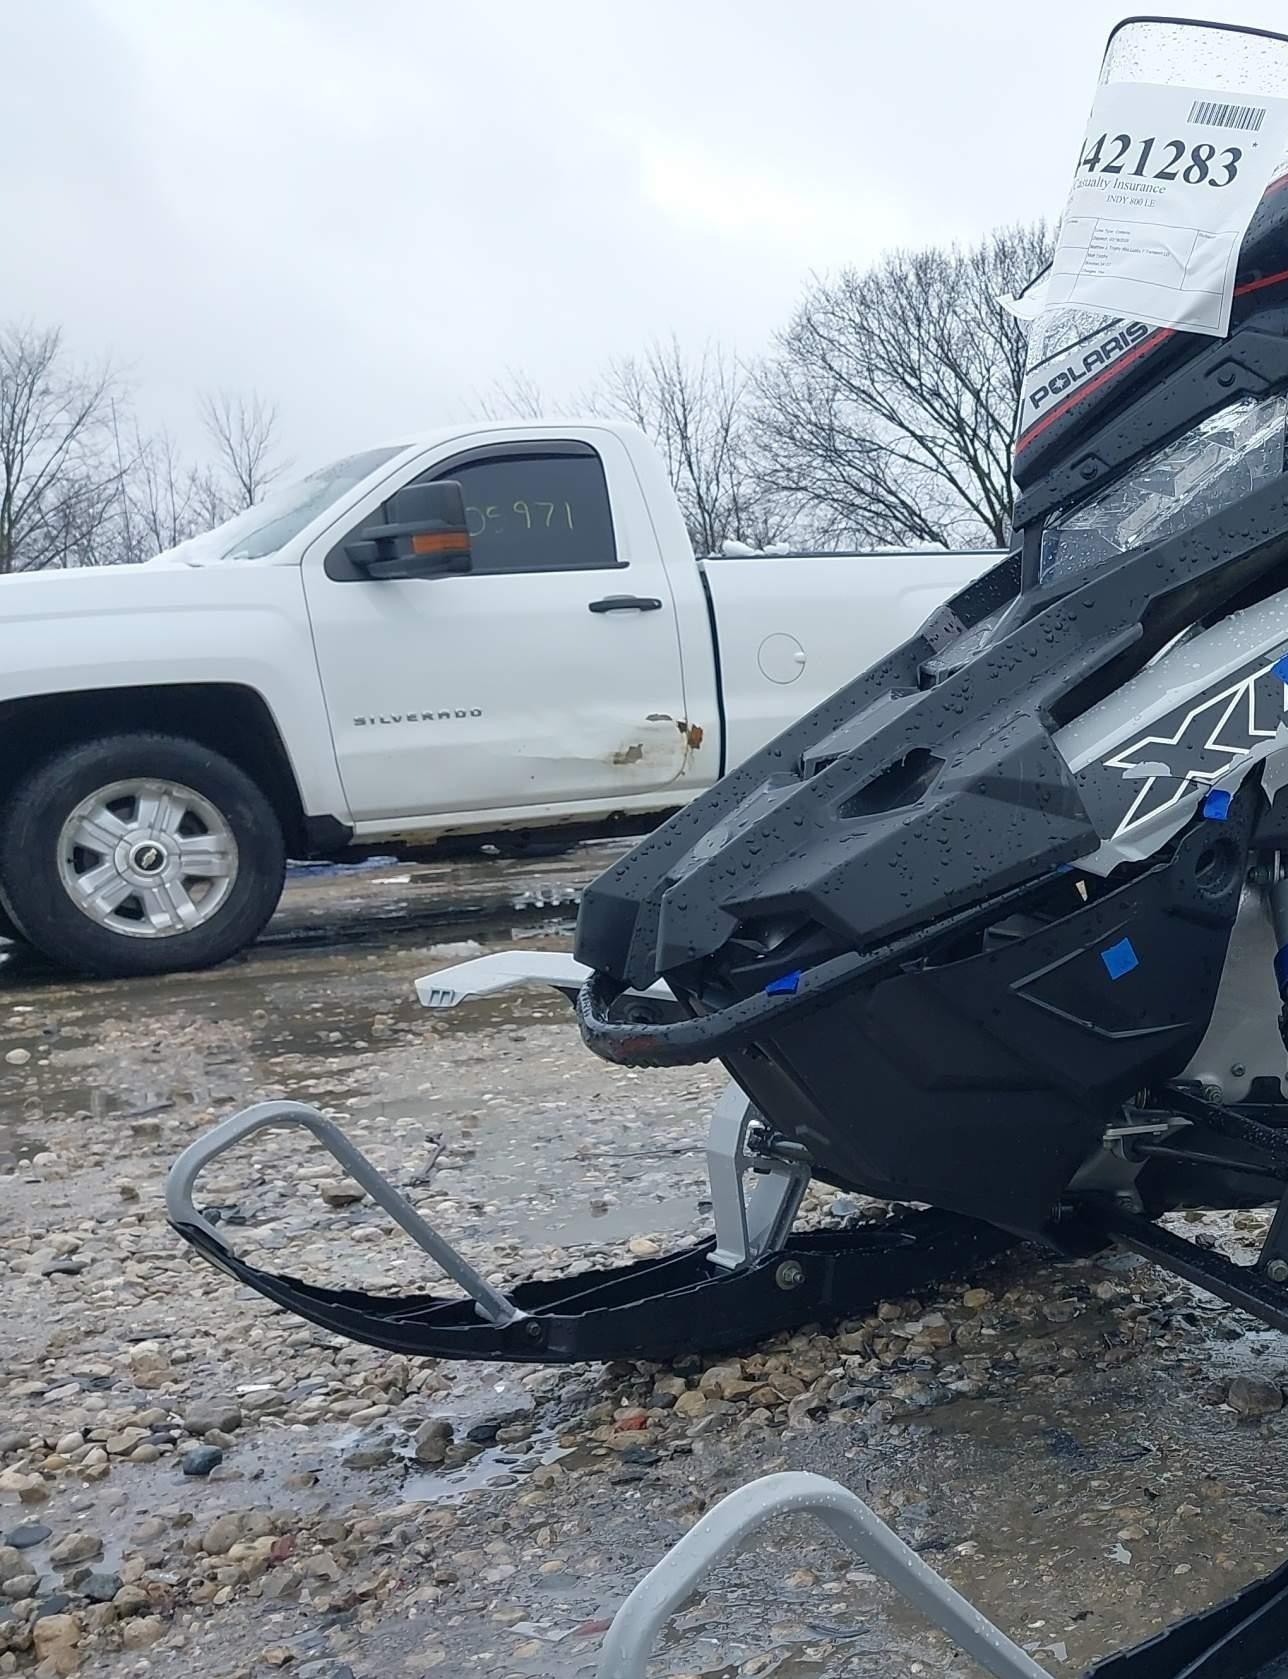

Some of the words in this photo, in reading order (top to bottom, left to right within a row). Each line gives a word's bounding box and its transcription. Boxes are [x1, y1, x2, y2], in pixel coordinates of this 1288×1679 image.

[1074, 133, 1242, 187] 421283
[1113, 177, 1167, 194] Insurance
[1106, 194, 1129, 204] INDY
[1129, 197, 1143, 206] 800
[1029, 321, 1149, 409] POLARIS
[353, 707, 482, 726] SILVERADO
